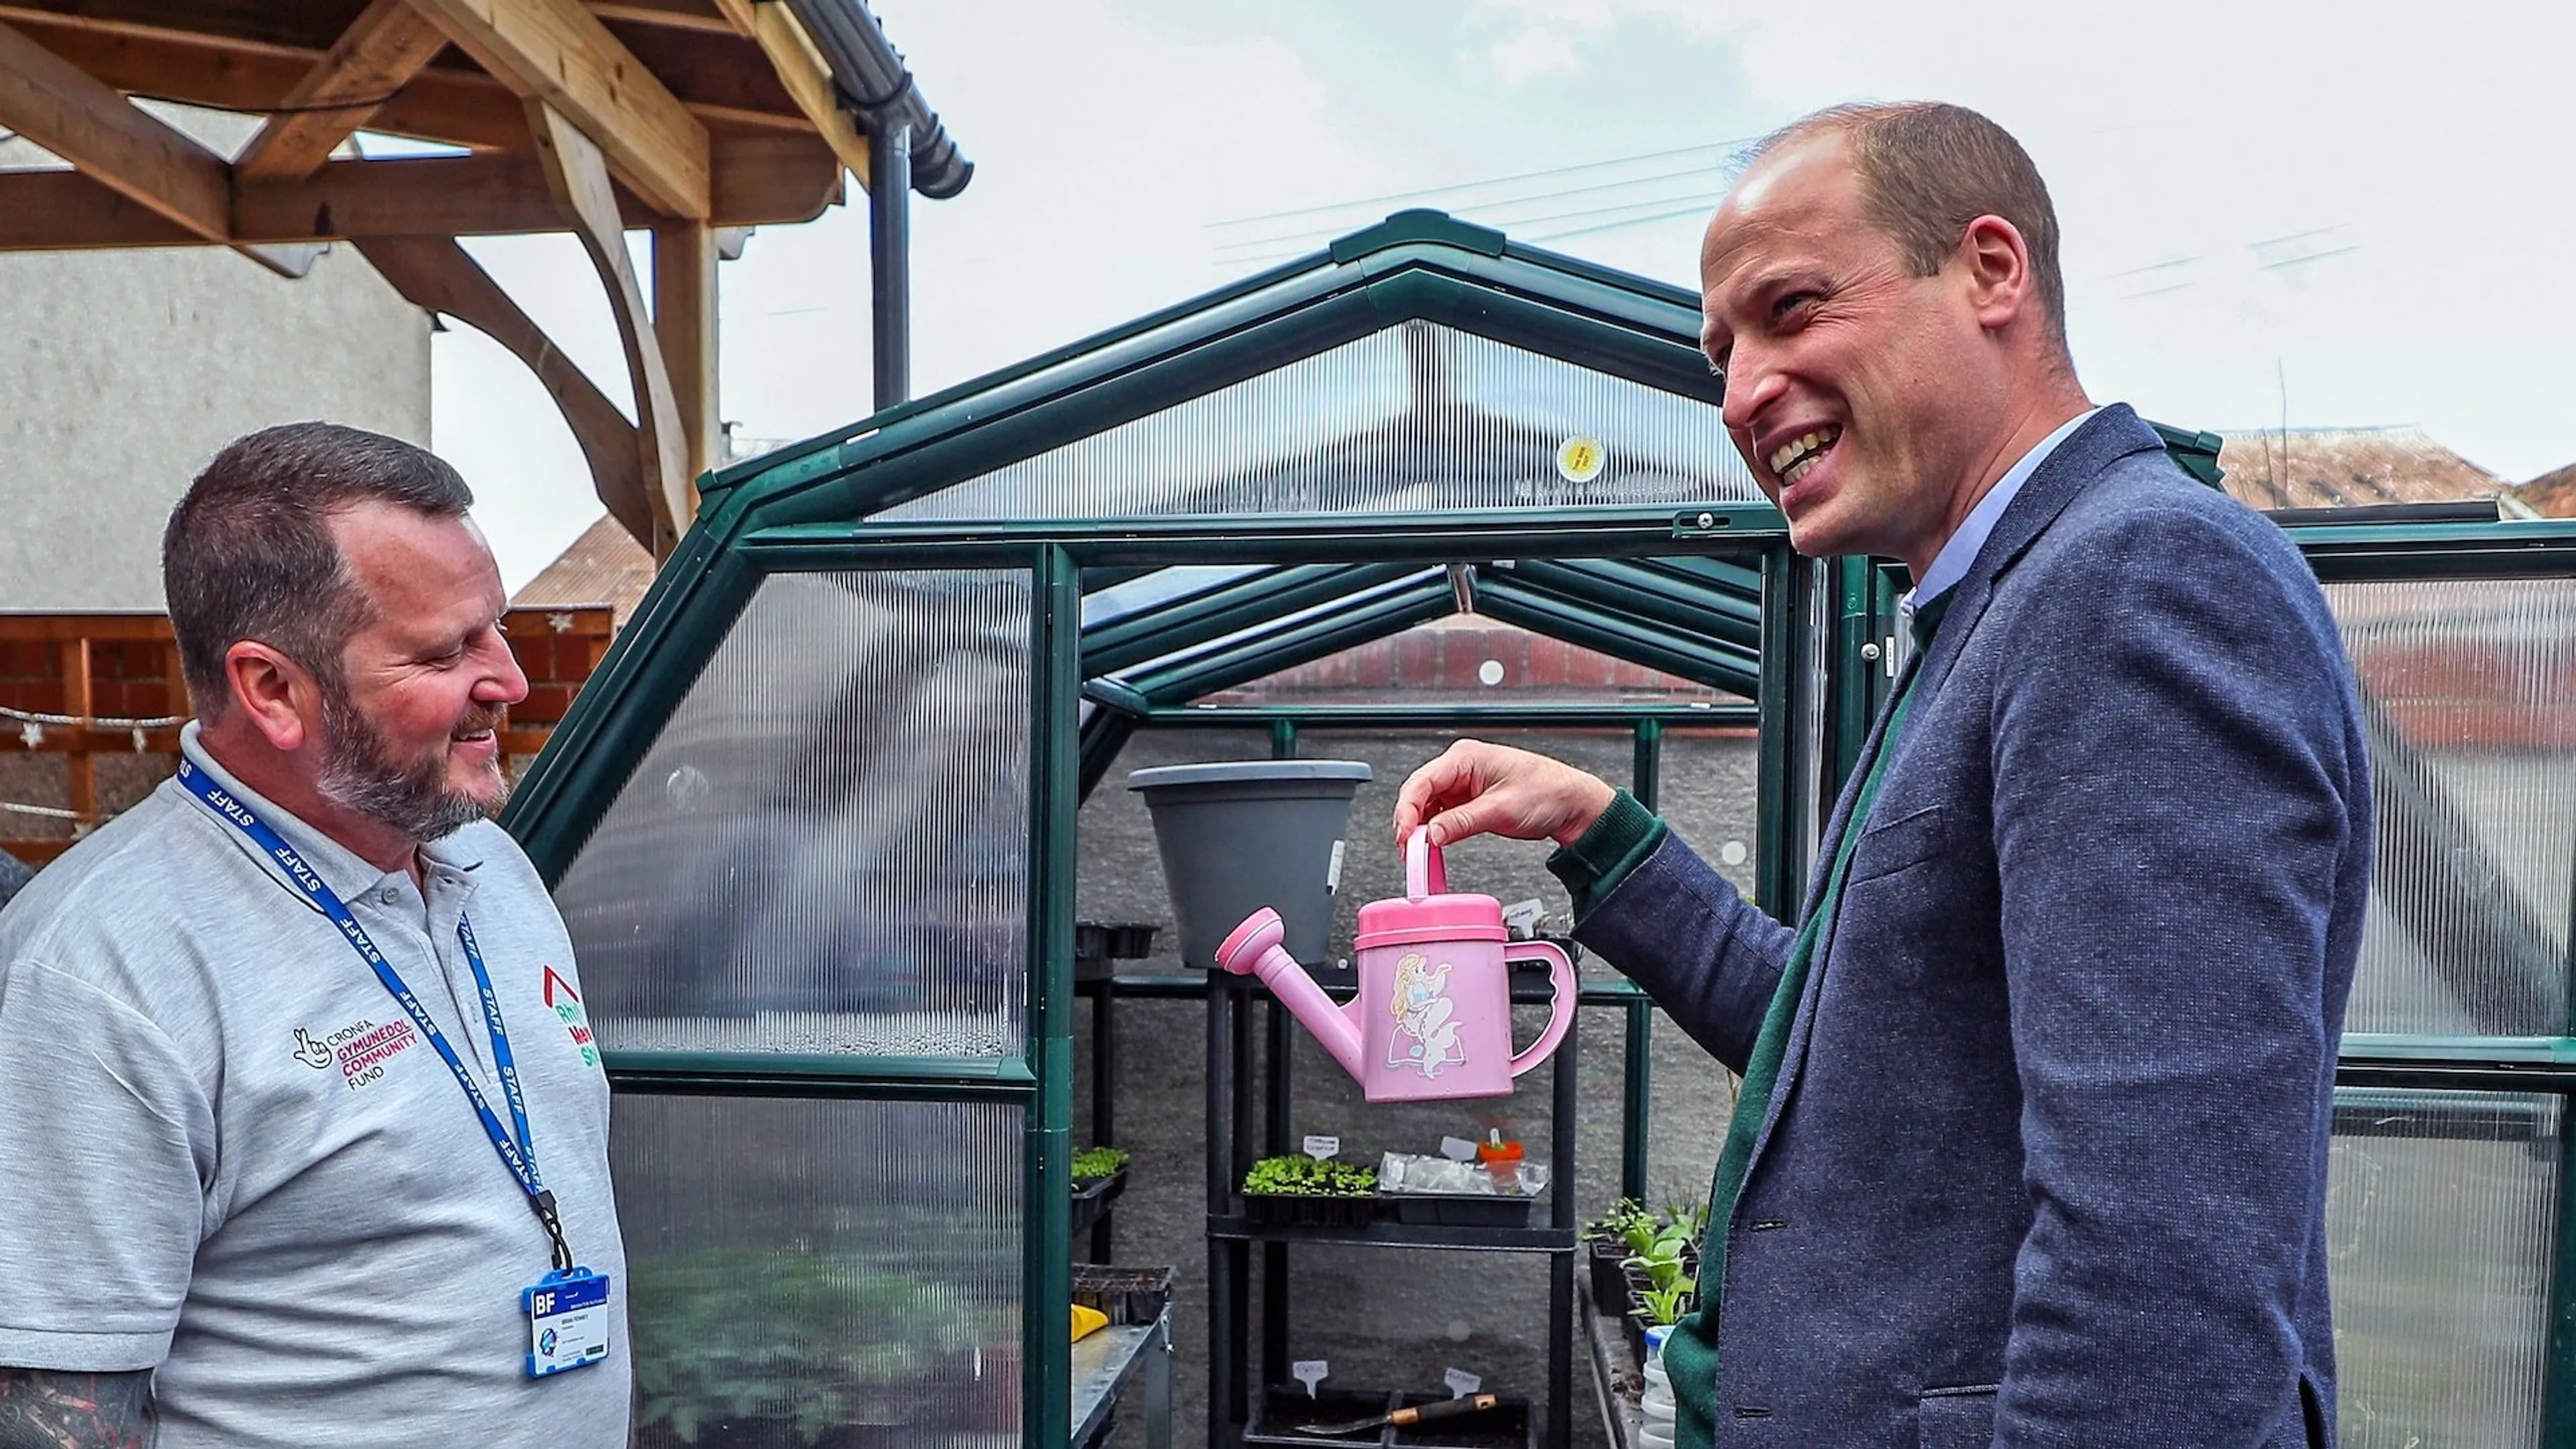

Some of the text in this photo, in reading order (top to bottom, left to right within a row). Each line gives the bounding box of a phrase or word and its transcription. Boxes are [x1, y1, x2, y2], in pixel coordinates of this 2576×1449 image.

[207, 790, 254, 826] STAFF
[274, 848, 321, 892] STAFF
[339, 918, 380, 963] STAFF
[326, 1020, 375, 1046] CRONFA
[399, 991, 437, 1036] STAFF
[483, 987, 503, 1036] STAFF
[337, 1018, 411, 1061] GYMUNEDOL
[342, 1032, 418, 1077] COMMUNITY
[347, 1065, 384, 1091] FUND
[454, 1064, 486, 1110] STAFF
[503, 1066, 524, 1115] STAFF
[499, 1139, 531, 1185] STAFF
[535, 1292, 555, 1316] BF
